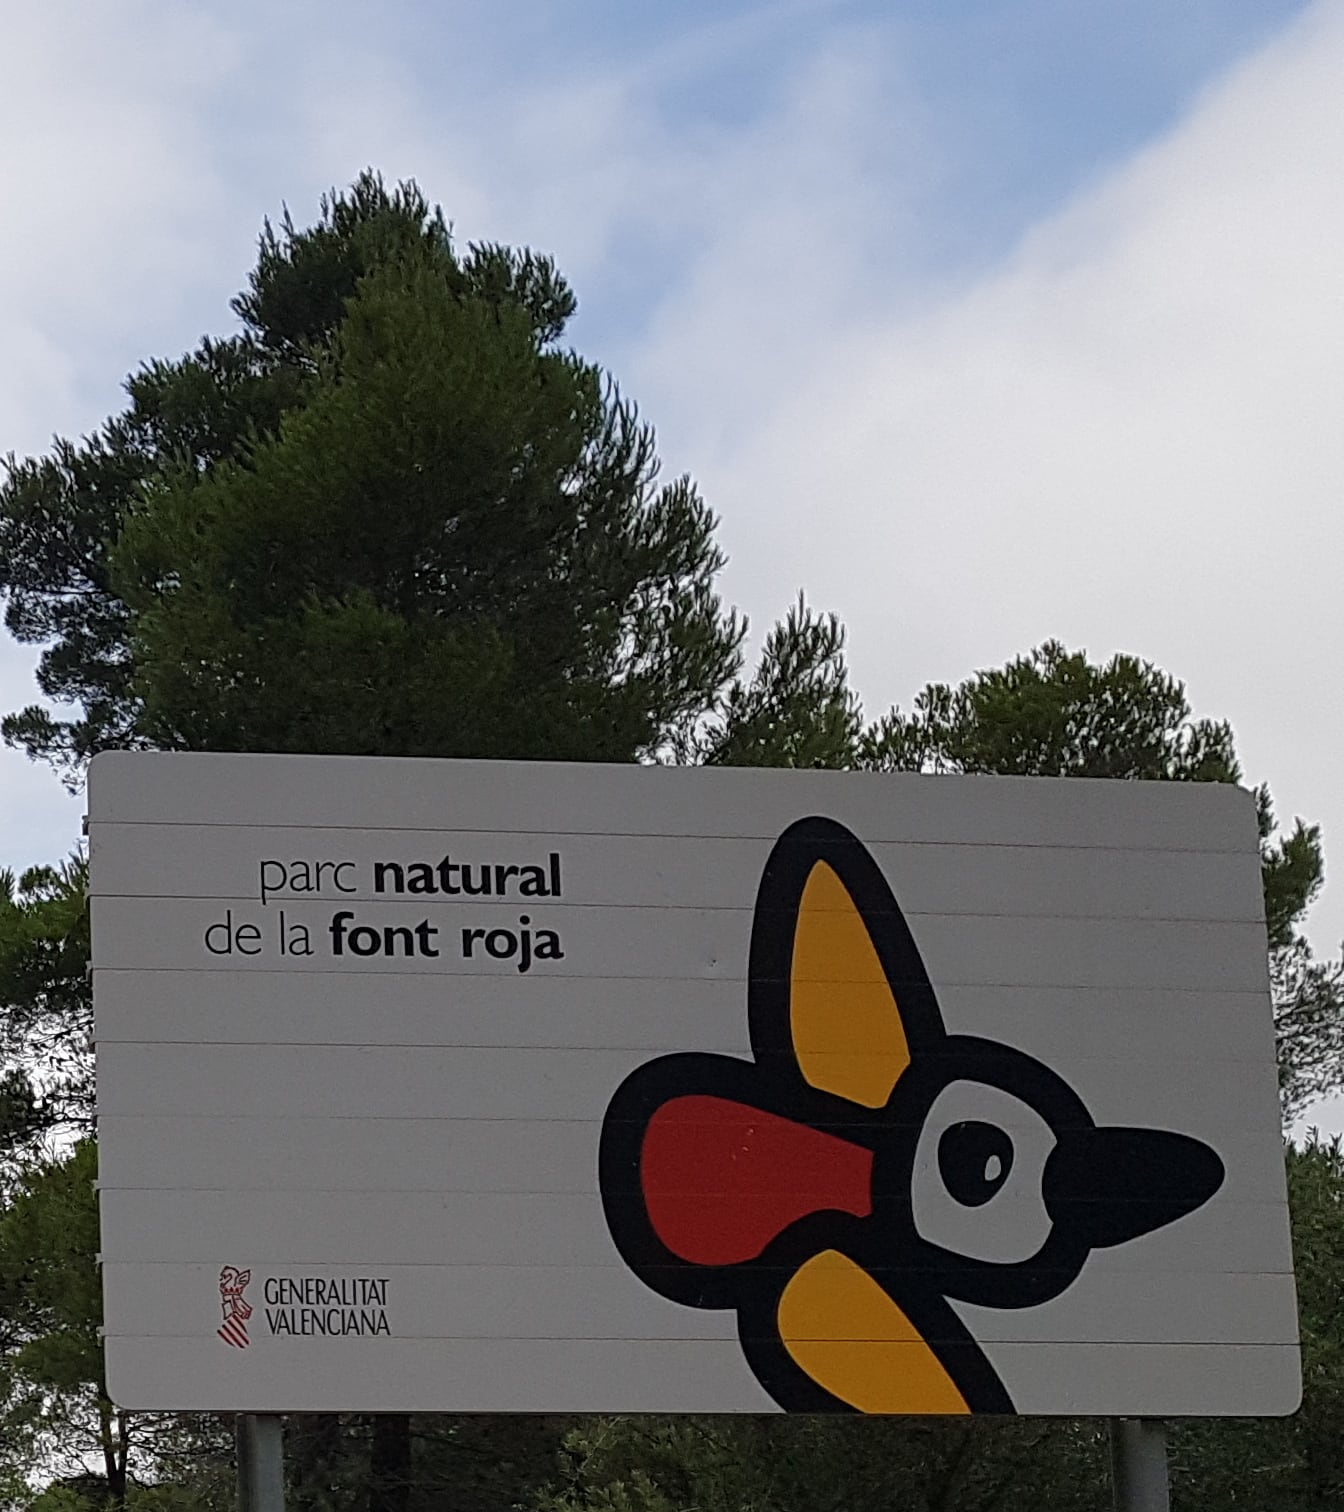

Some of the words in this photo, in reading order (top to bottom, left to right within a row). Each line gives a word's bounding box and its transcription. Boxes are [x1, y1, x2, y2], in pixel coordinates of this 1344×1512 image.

[260, 860, 357, 905] parc
[374, 853, 562, 897] natural
[205, 910, 262, 955] de
[280, 911, 314, 956] la
[329, 911, 440, 957] font
[462, 915, 564, 973] roja
[265, 1278, 390, 1306] GENERALITAT
[265, 1308, 391, 1336] VALENCIANA
